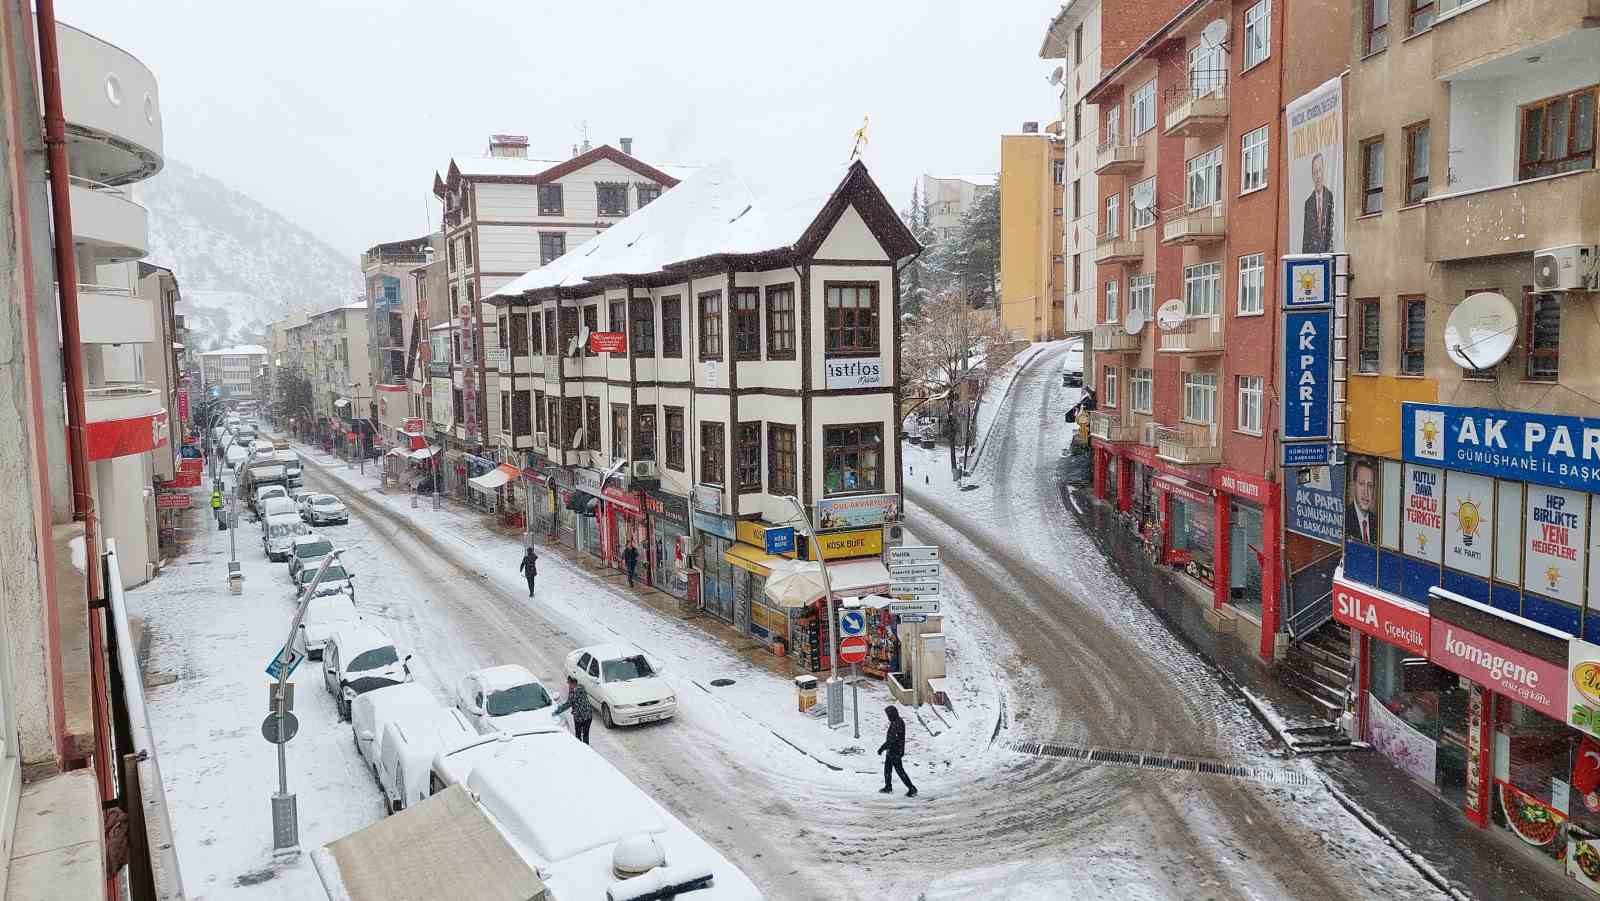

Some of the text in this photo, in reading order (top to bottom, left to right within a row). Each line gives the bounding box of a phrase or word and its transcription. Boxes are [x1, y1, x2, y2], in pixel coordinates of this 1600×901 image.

[1299, 320, 1317, 432] AK PARTİ
[1456, 416, 1508, 449] AK
[1456, 449, 1538, 472] GÜMÜŞHANE
[1542, 457, 1555, 474] İL
[1412, 470, 1437, 487] KUTLU
[1296, 490, 1312, 505] AK
[1415, 483, 1433, 497] DAVA
[1546, 494, 1566, 510] HEP
[1406, 508, 1441, 530] TÜRKİYE
[1533, 507, 1578, 529] BİRLİKTE
[1541, 524, 1569, 546] YENİ
[1453, 545, 1463, 554] AK
[1337, 592, 1379, 628] SILA
[1445, 628, 1538, 688] komagene
